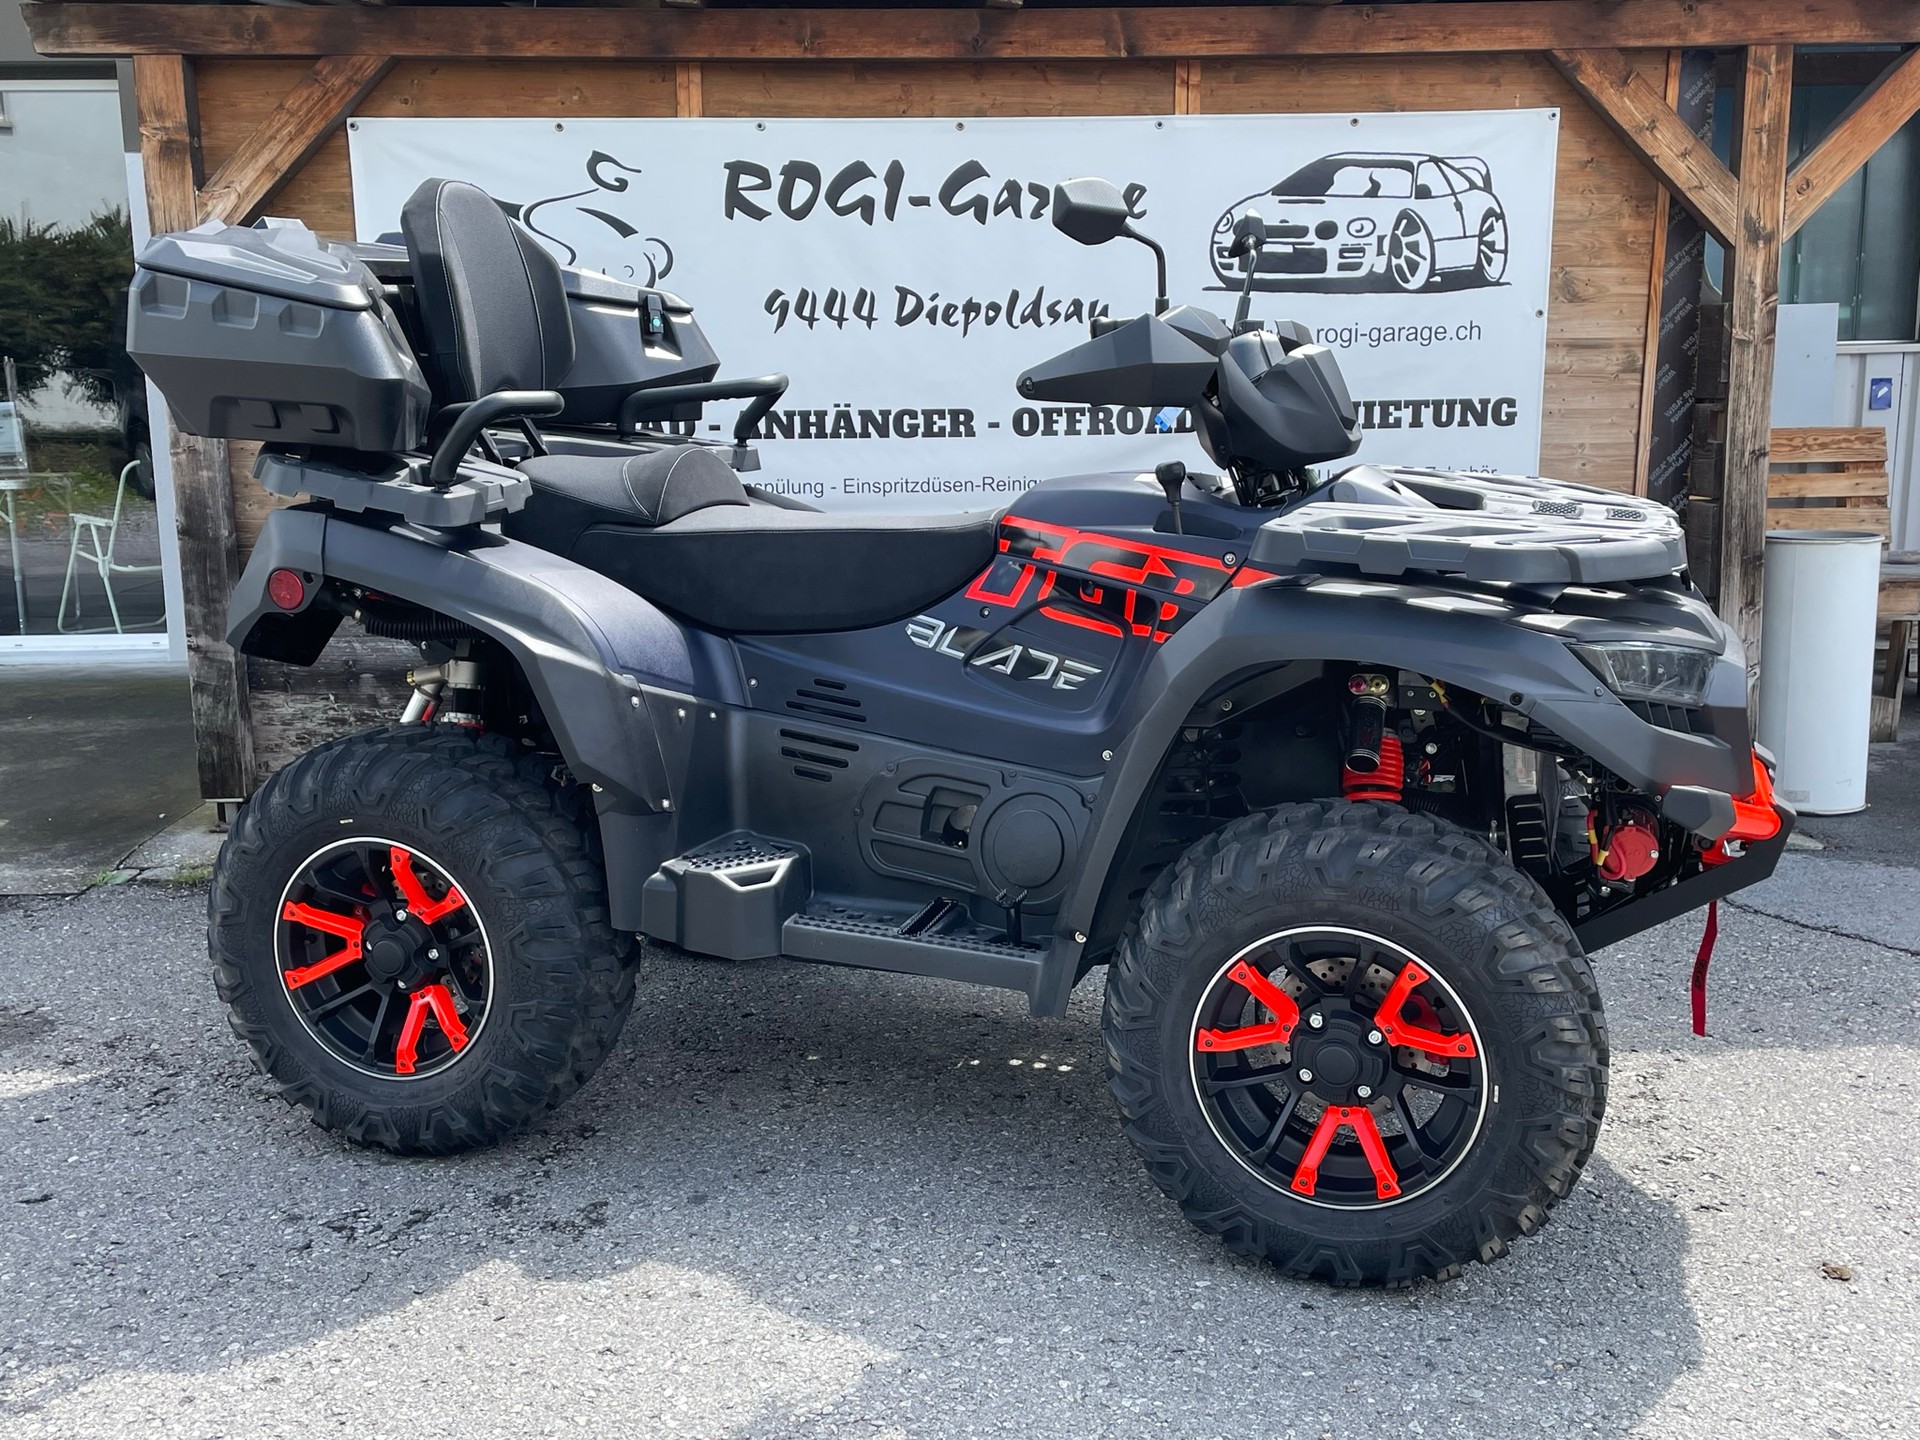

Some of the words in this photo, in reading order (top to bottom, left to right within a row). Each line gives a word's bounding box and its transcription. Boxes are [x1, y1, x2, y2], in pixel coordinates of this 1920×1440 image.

[723, 159, 1148, 226] ROGI-Gare
[764, 286, 879, 334] 9444
[1352, 397, 1518, 430] IETUNG
